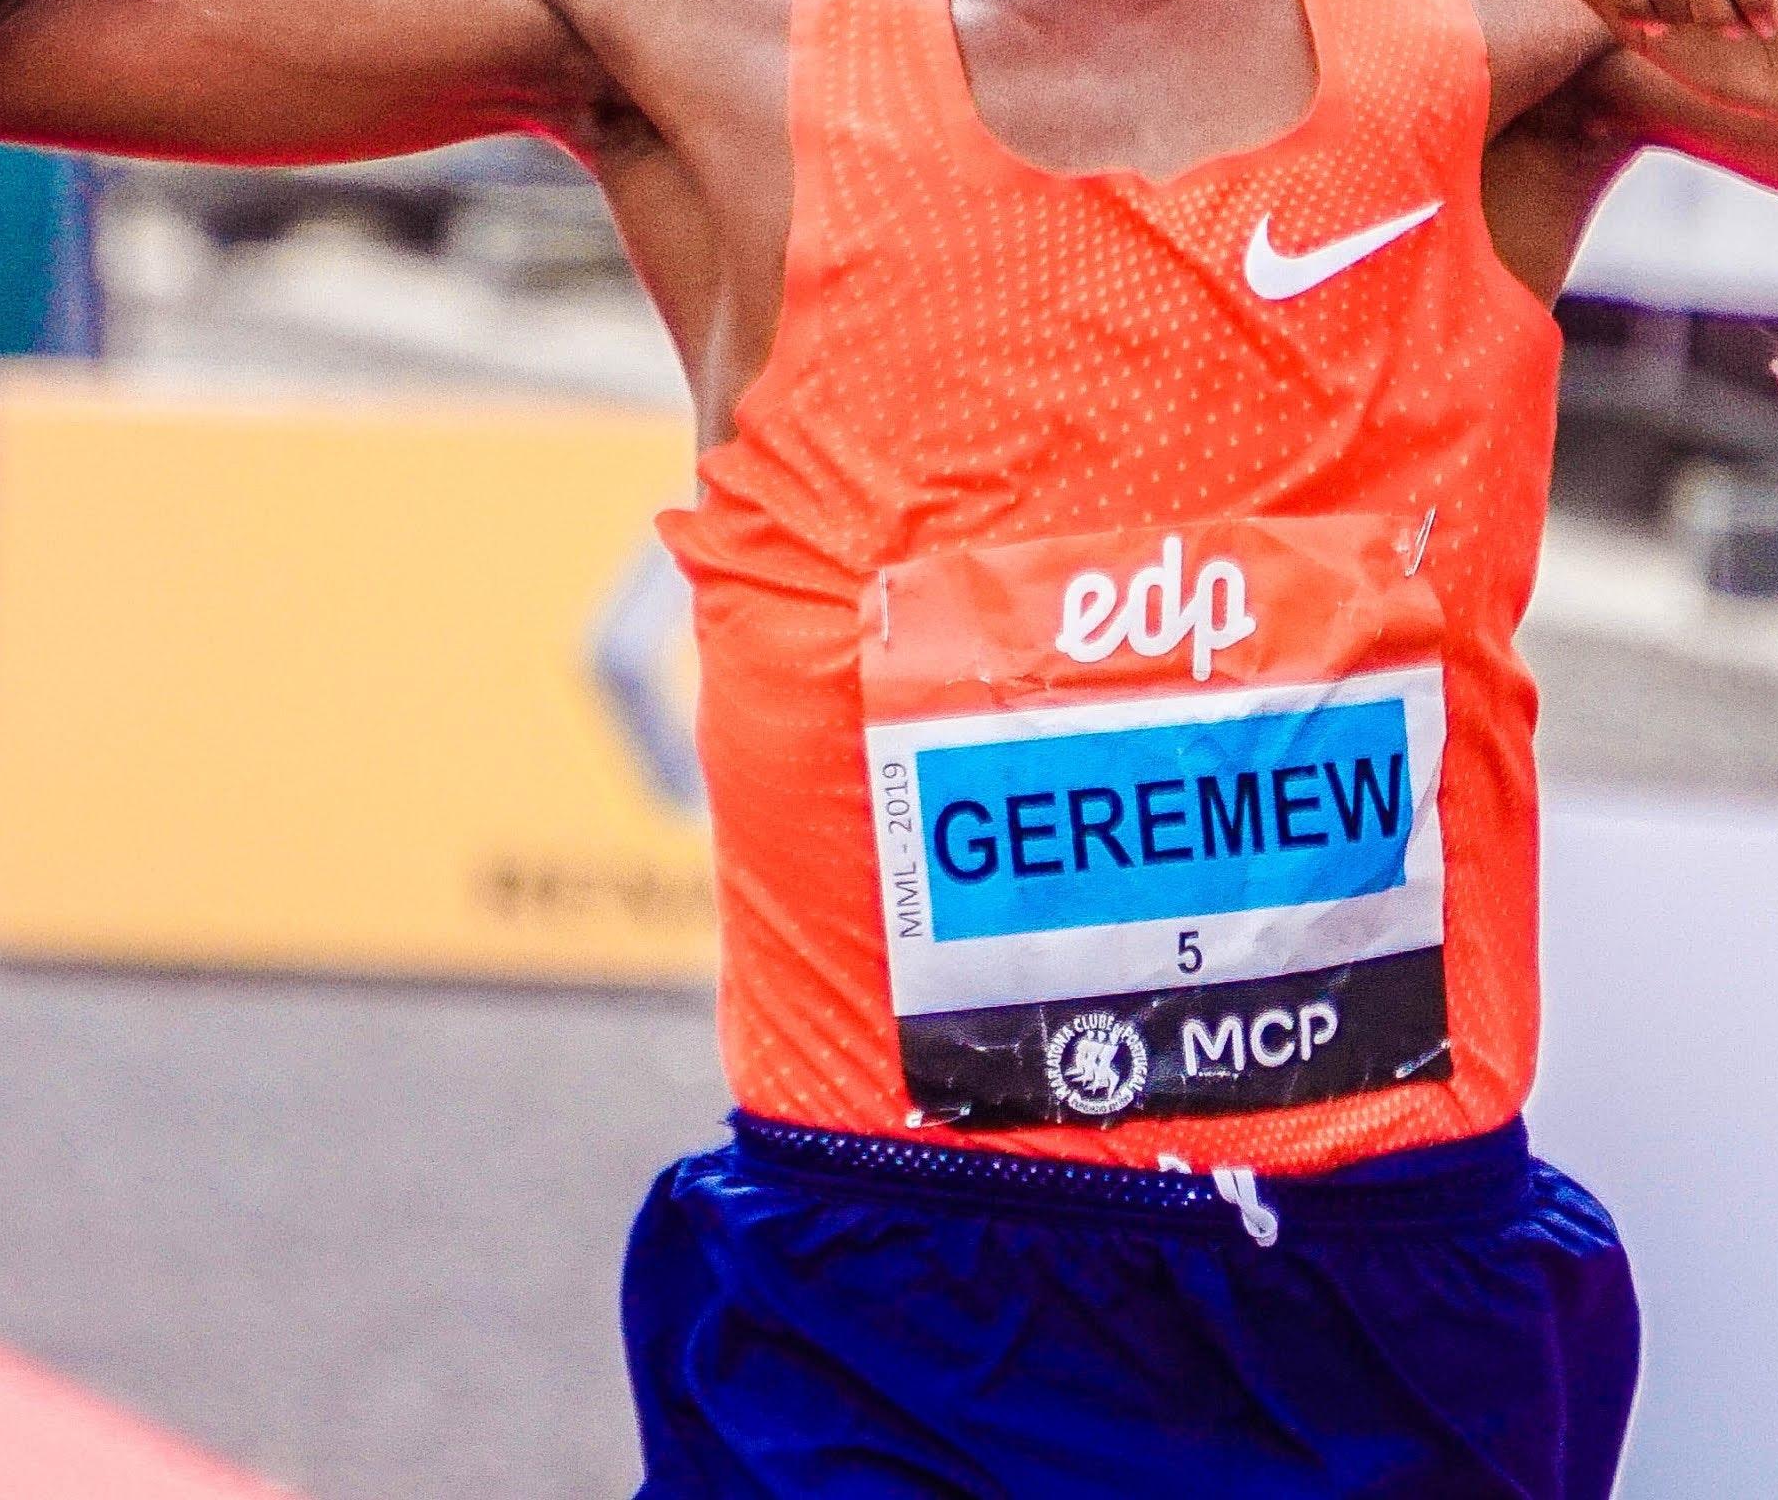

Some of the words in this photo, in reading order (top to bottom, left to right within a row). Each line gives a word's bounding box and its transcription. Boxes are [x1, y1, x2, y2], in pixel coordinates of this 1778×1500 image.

[1055, 535, 1257, 682] edp
[882, 762, 913, 835] 2019
[932, 752, 1404, 886] GEREMEW
[894, 861, 924, 939] MML
[1175, 931, 1203, 974] 5
[1073, 1013, 1115, 1033] CLUBE
[1182, 1002, 1339, 1077] MCP
